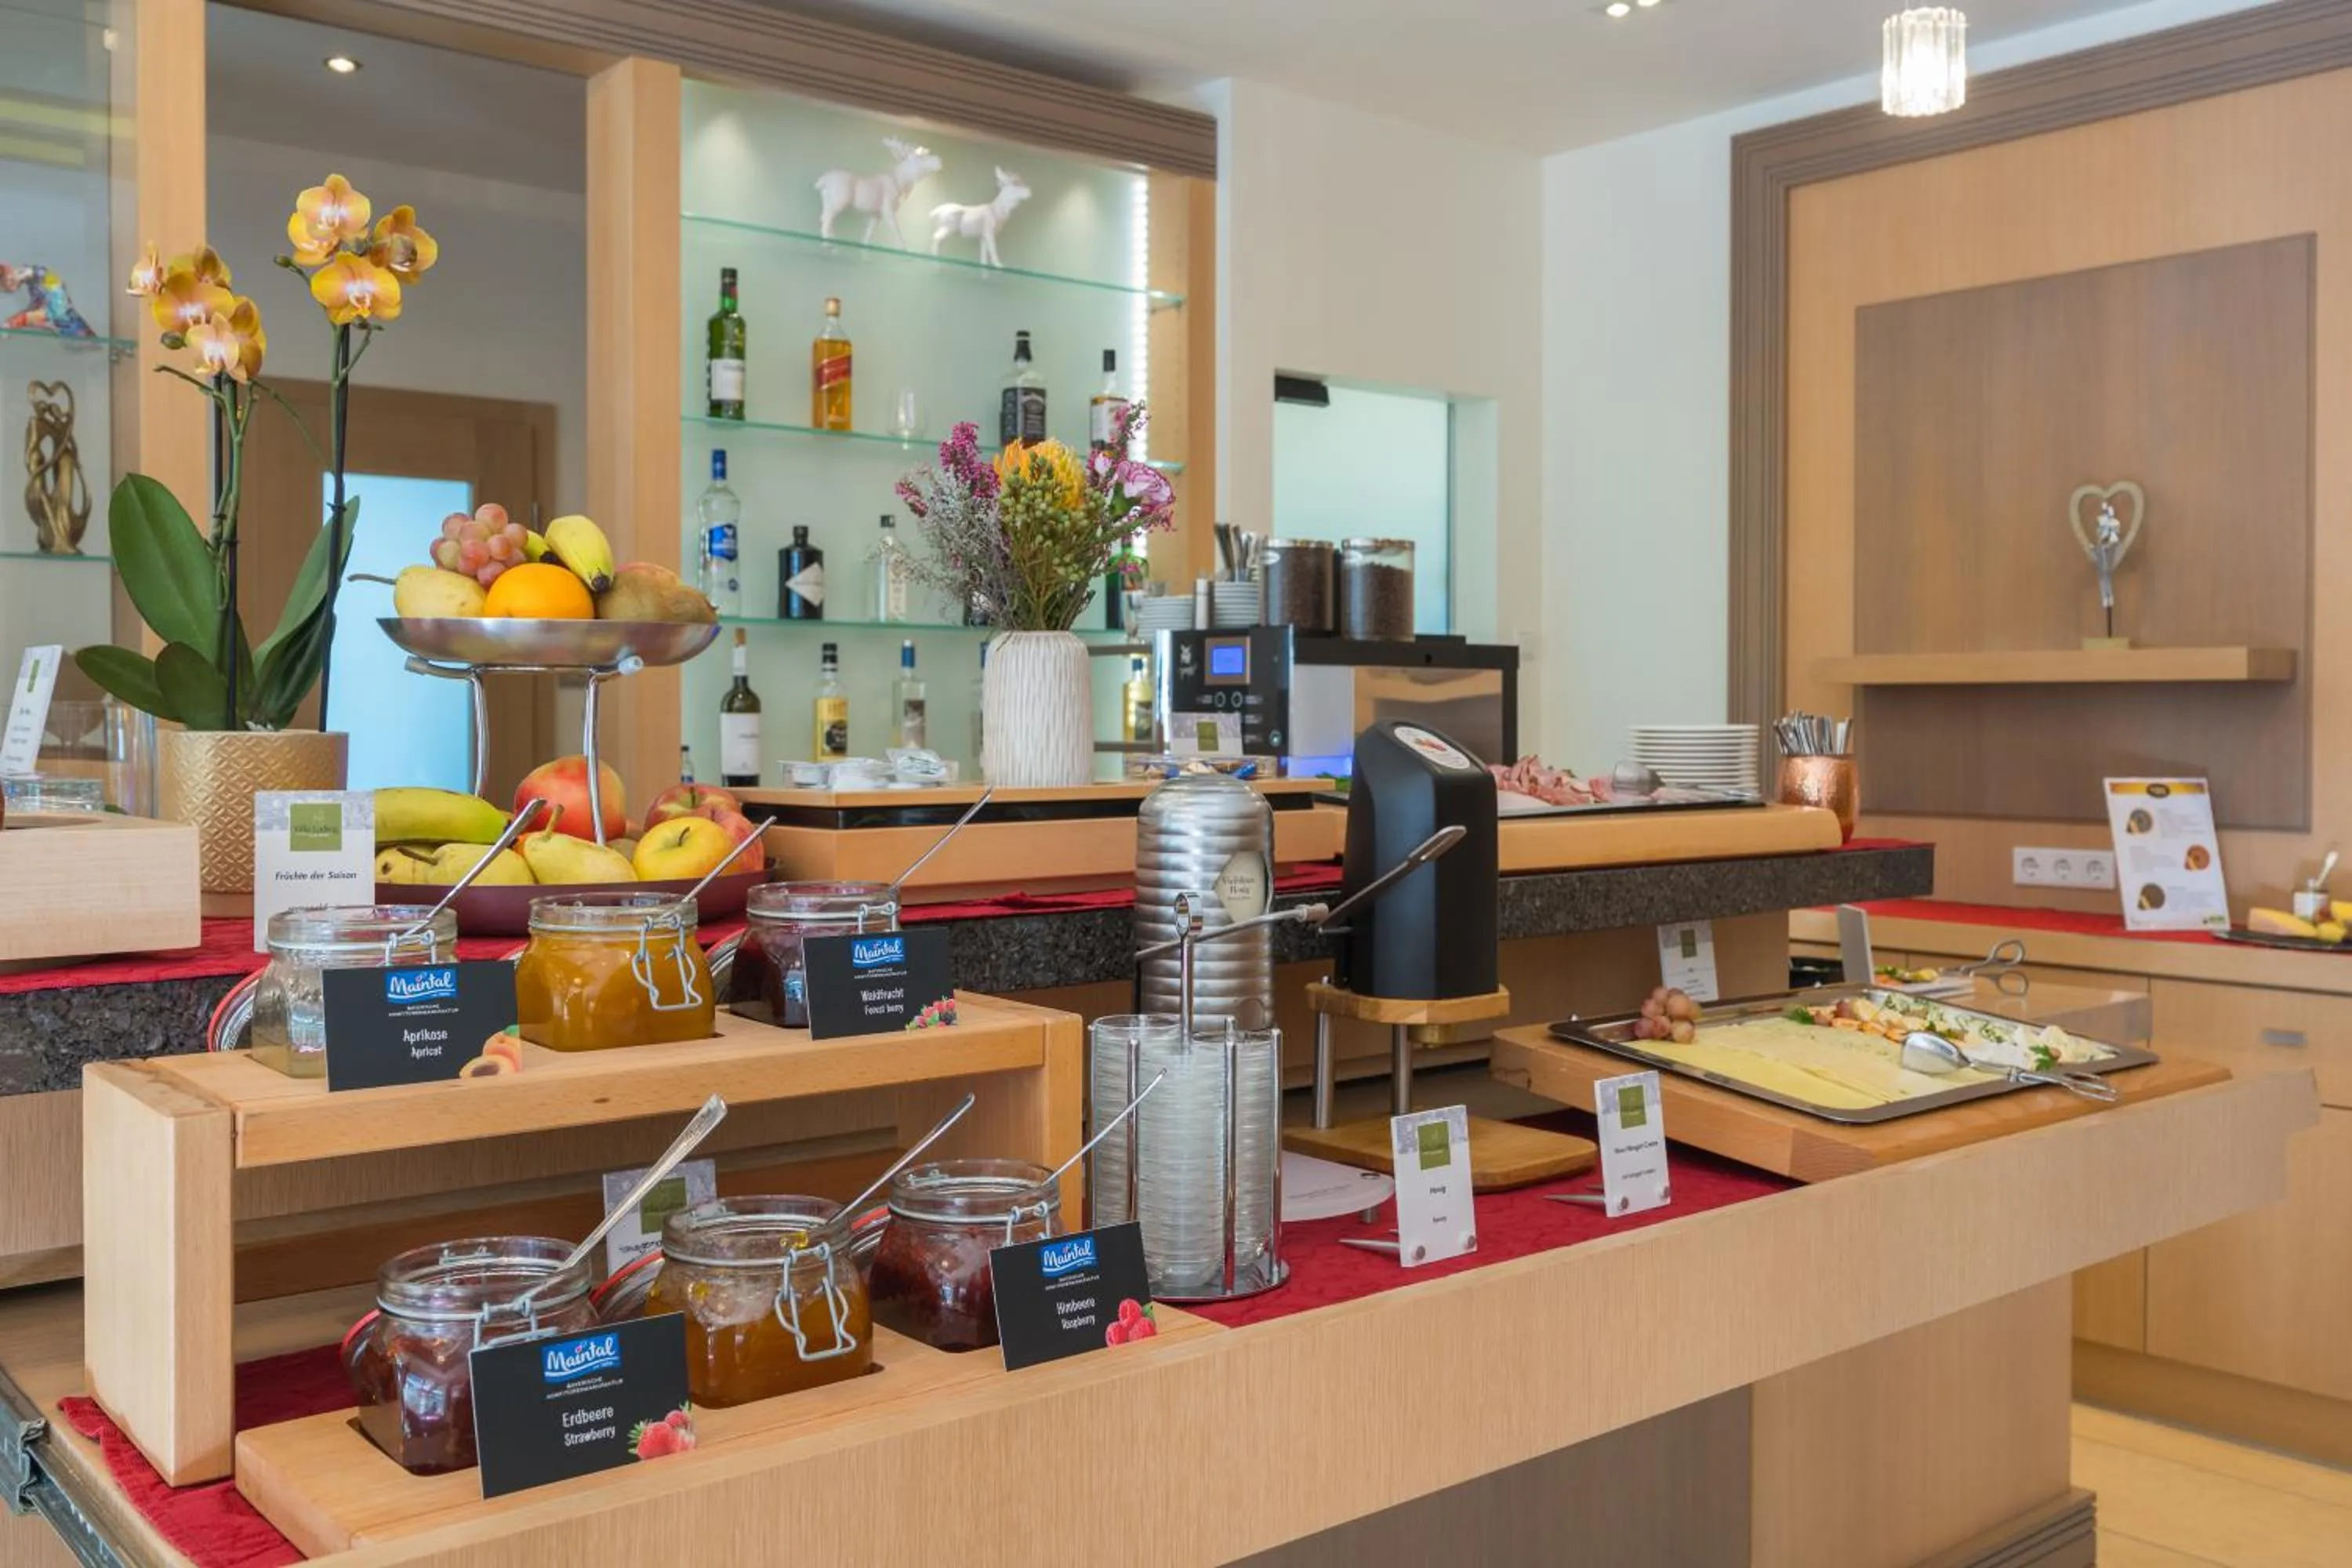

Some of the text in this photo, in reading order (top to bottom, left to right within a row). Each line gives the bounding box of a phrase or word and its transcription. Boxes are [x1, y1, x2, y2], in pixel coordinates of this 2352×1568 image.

[275, 871, 308, 880] Früchte
[310, 870, 325, 879] der
[855, 939, 902, 960] Maintal
[390, 971, 452, 996] Maintal
[403, 1029, 448, 1044] Aprikose
[411, 1046, 443, 1059] Apricot
[1043, 1240, 1093, 1268] Maintal
[1056, 1298, 1095, 1315] Himbeere
[546, 1336, 615, 1372] Maintal
[562, 1406, 614, 1428] Erdbeere
[564, 1426, 615, 1446] Strawberry
